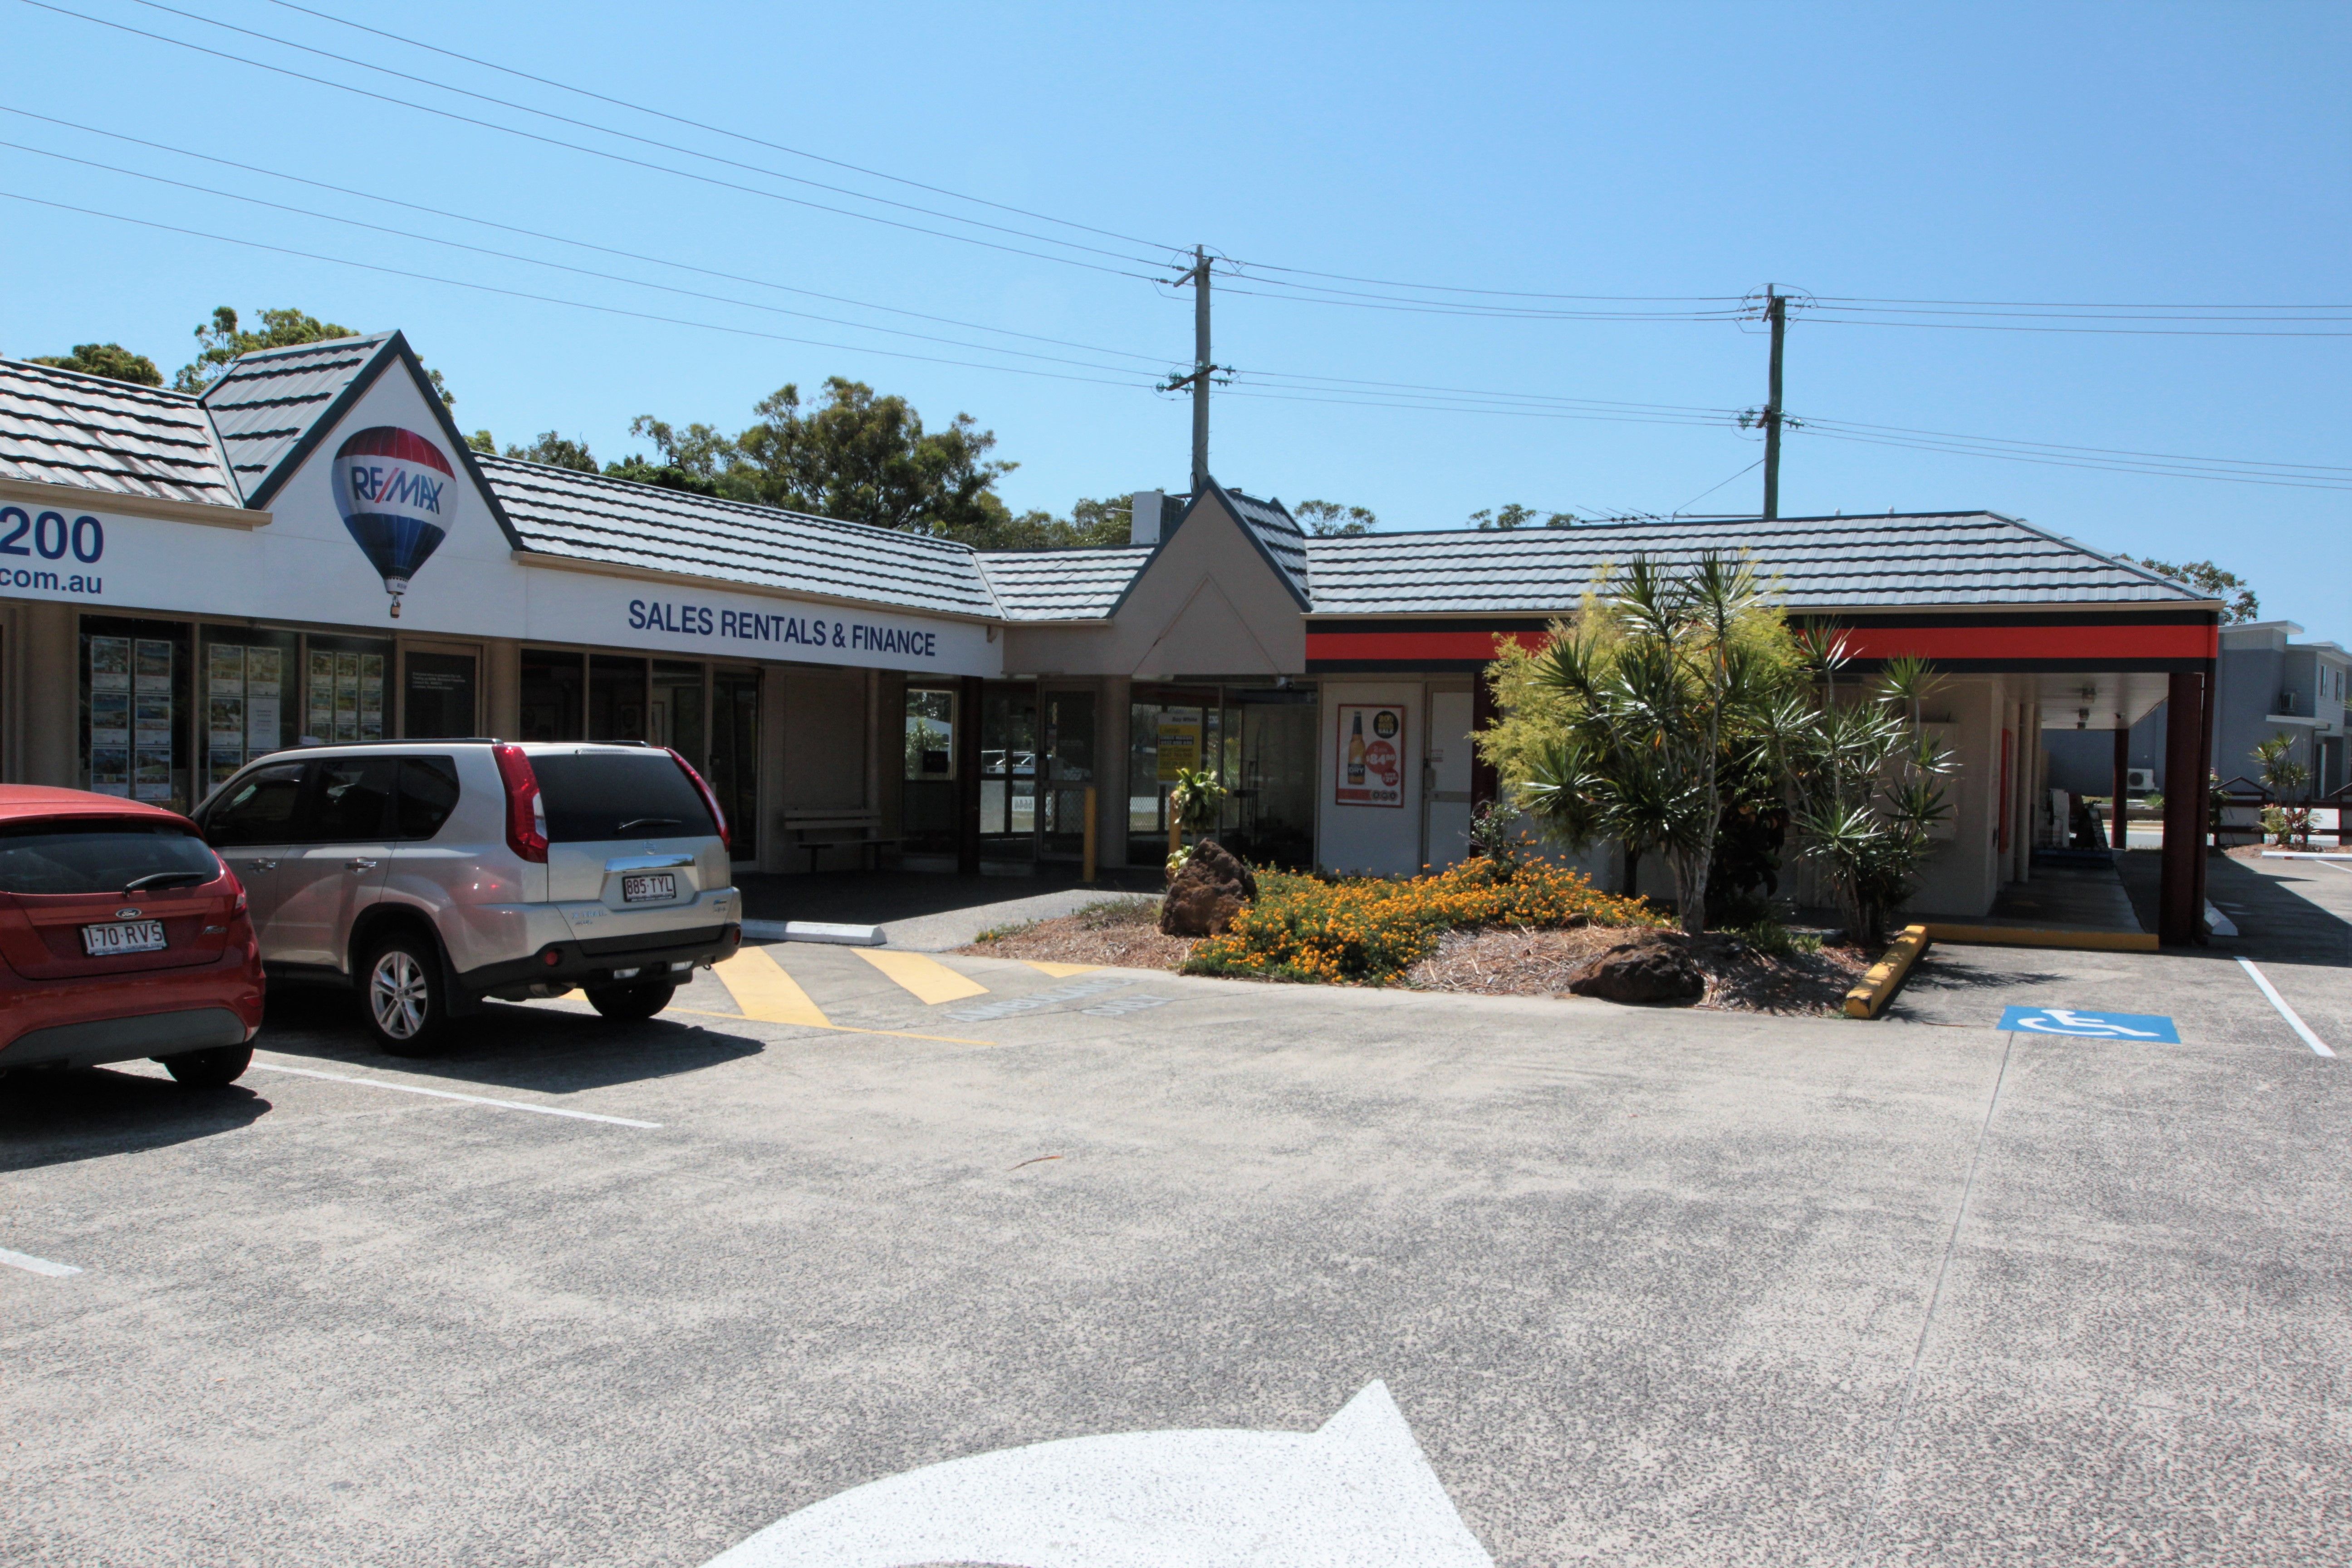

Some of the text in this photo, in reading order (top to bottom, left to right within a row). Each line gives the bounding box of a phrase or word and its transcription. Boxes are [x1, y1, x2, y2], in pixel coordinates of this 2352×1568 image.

[351, 466, 443, 514] RE/MAX
[0, 506, 104, 564] 200
[0, 568, 102, 594] com.au
[629, 599, 936, 657] SALES RENTALS & FINANCE
